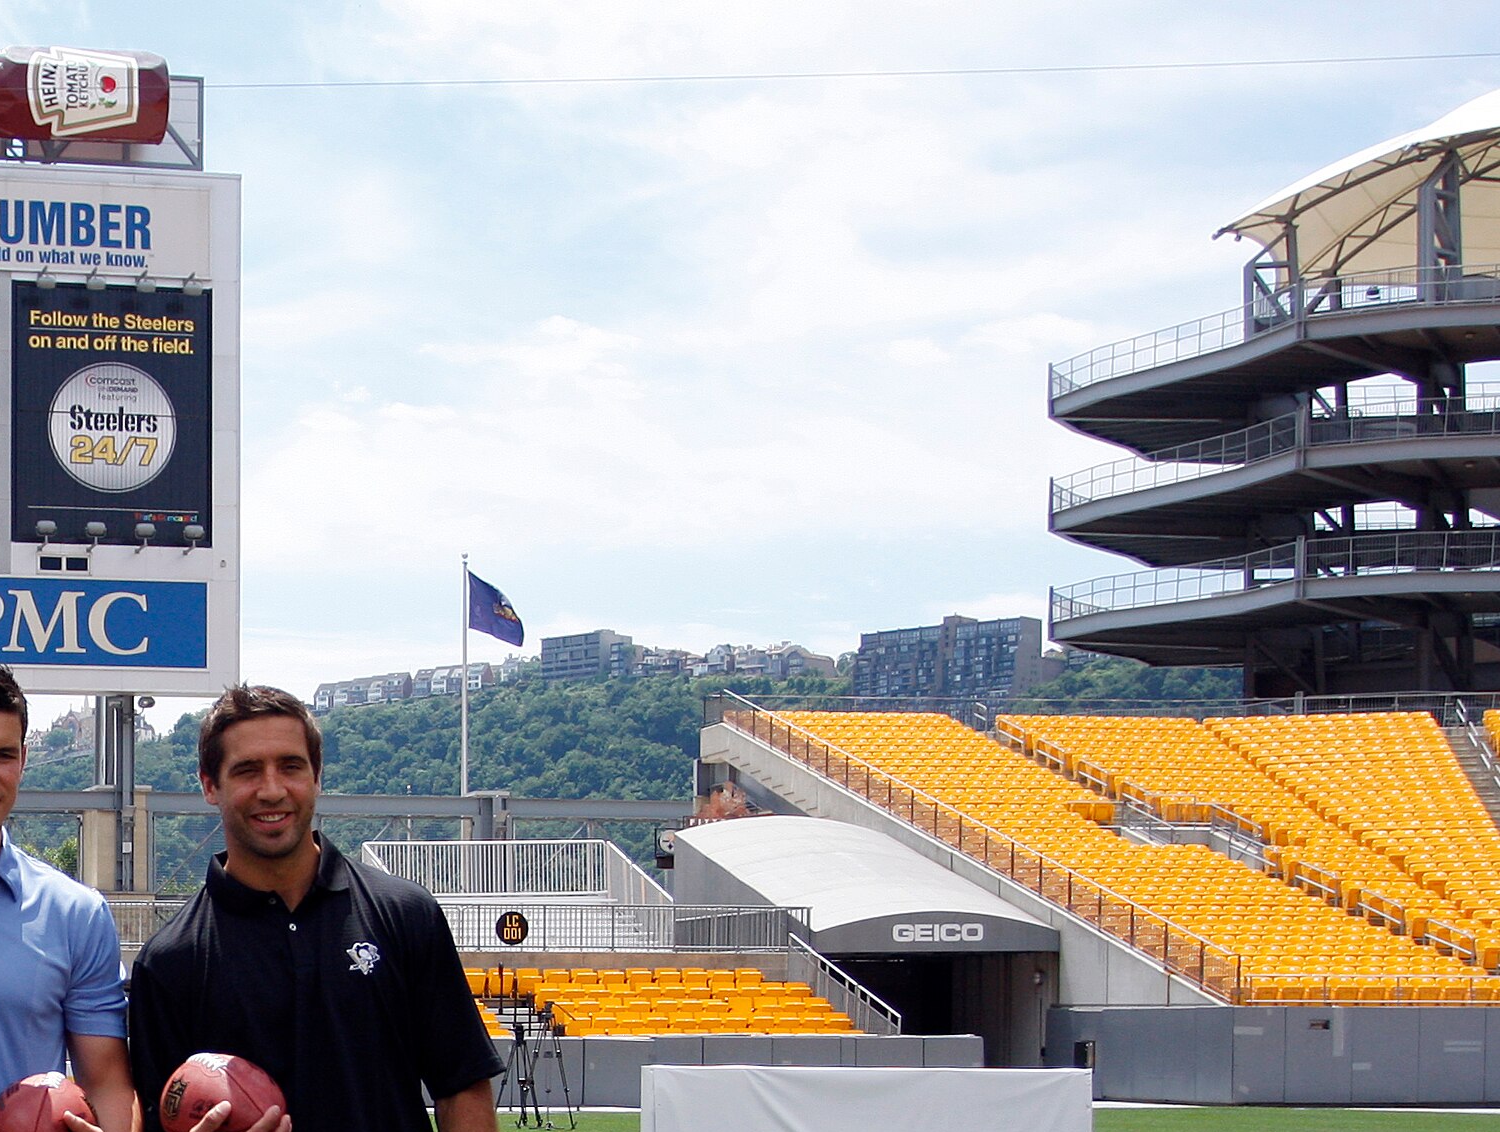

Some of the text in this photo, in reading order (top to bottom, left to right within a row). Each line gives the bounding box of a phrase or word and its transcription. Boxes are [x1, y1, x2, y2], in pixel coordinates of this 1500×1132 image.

[42, 62, 59, 108] HEINZ
[79, 64, 89, 108] KETCHU
[15, 250, 34, 264] on
[38, 249, 75, 266] what
[79, 253, 101, 266] we
[106, 251, 149, 269] know.
[29, 309, 194, 332] Follow the Steelers
[29, 334, 194, 354] on and off the field.
[69, 404, 158, 433] Steelers
[70, 435, 158, 466] 24/7
[506, 914, 519, 927] LC
[503, 927, 522, 940] 001
[892, 923, 984, 943] GEICO
